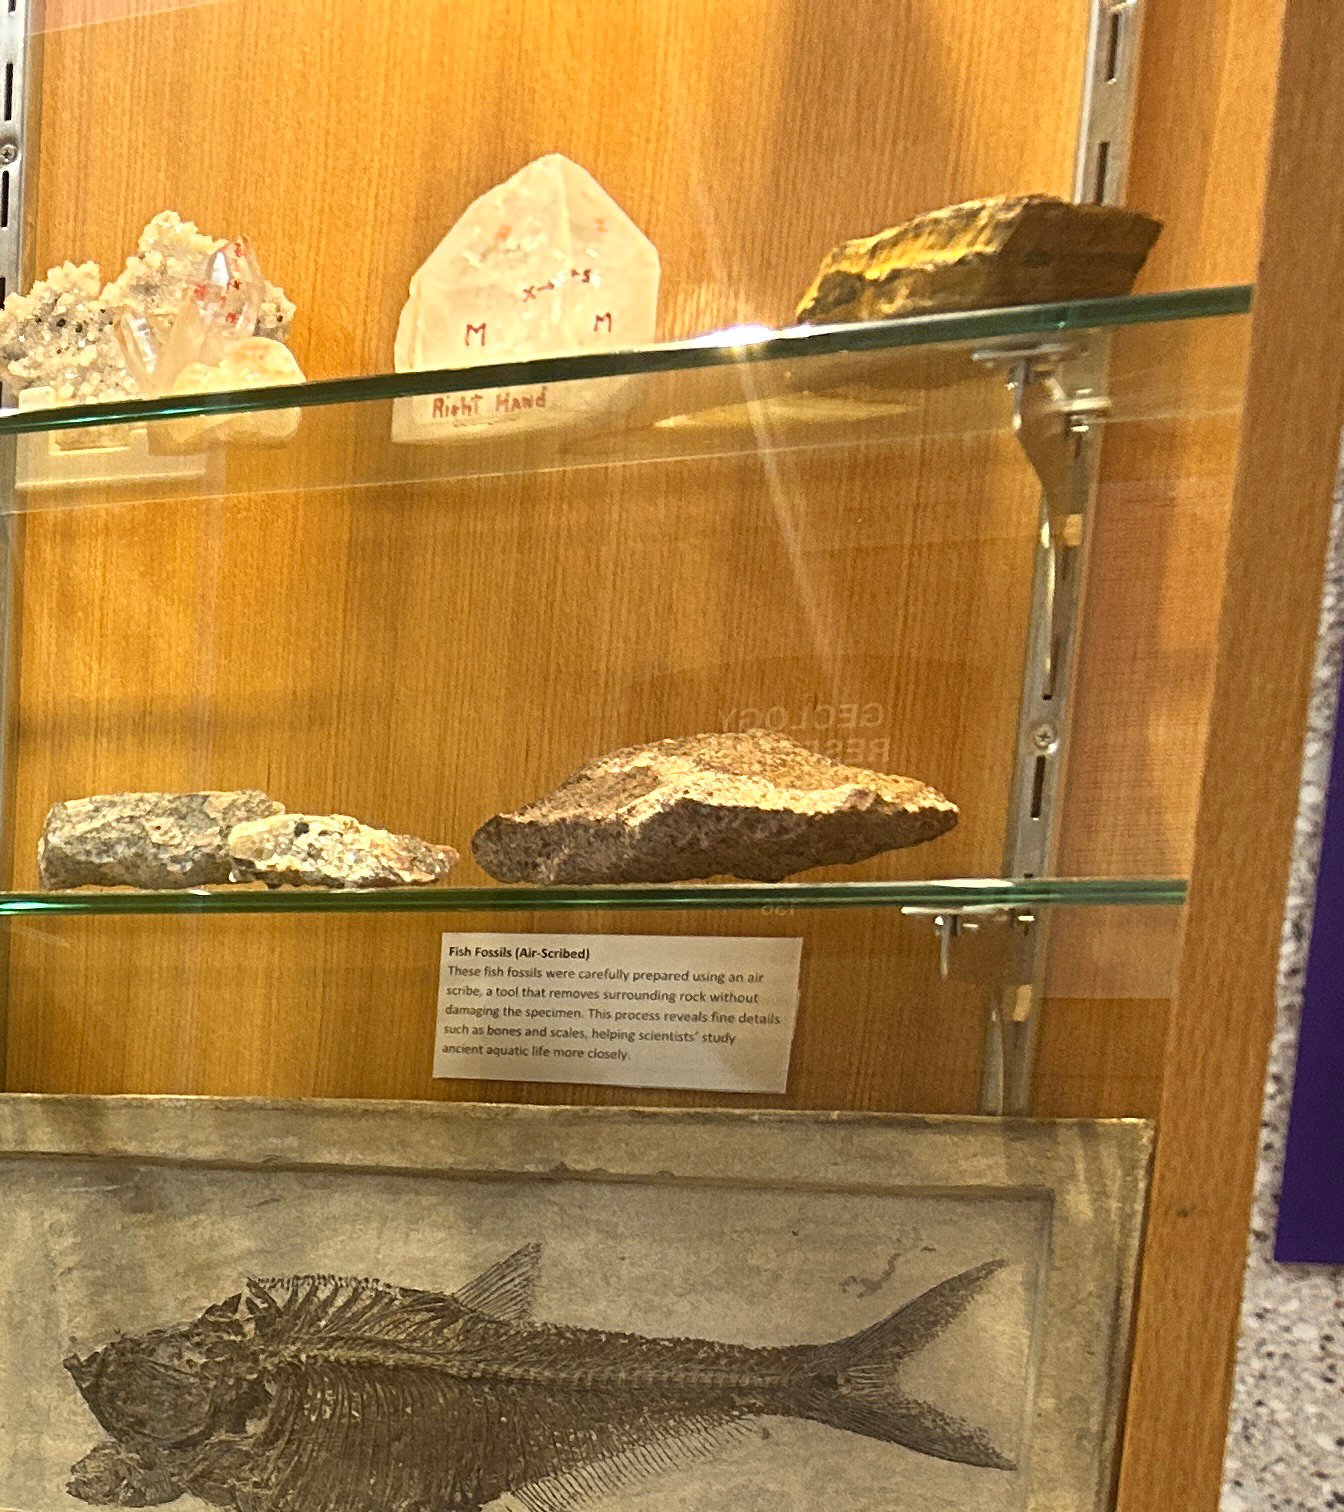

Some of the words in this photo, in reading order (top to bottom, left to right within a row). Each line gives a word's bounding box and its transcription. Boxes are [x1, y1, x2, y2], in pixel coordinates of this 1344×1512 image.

[449, 947, 471, 957] Fish
[475, 947, 512, 958] Fossils
[515, 948, 590, 960] (Air-Scribed)
[448, 966, 481, 976] These
[484, 966, 504, 978] fish
[506, 966, 542, 978] fossils
[546, 970, 576, 978] were
[578, 968, 630, 981] carefully
[632, 970, 689, 982] prepared
[692, 972, 725, 984] using
[729, 974, 744, 982] an
[748, 972, 764, 983] air
[446, 986, 481, 997] scribe,
[486, 988, 492, 996] a
[496, 986, 518, 998] tool
[522, 987, 546, 998] that
[549, 990, 600, 1000] removes
[603, 990, 676, 1004] surrounding
[680, 991, 706, 1002] rock
[710, 992, 758, 1004] without
[445, 1004, 499, 1018] damaging
[503, 1006, 522, 1017] the
[525, 1008, 584, 1020] specimen.
[588, 1008, 612, 1019] This
[614, 1011, 660, 1022] process
[664, 1012, 708, 1022] reveals
[712, 1012, 735, 1024] fine
[738, 1012, 781, 1024] details
[444, 1024, 469, 1034] such
[472, 1026, 484, 1036] as
[487, 1025, 522, 1037] bones
[525, 1026, 547, 1038] and
[550, 1027, 588, 1040] scales,
[592, 1028, 634, 1042] helping
[702, 1032, 736, 1045] study
[442, 1044, 484, 1055] ancient
[486, 1046, 528, 1059] aquatic
[532, 1046, 550, 1056] life
[554, 1048, 584, 1058] more
